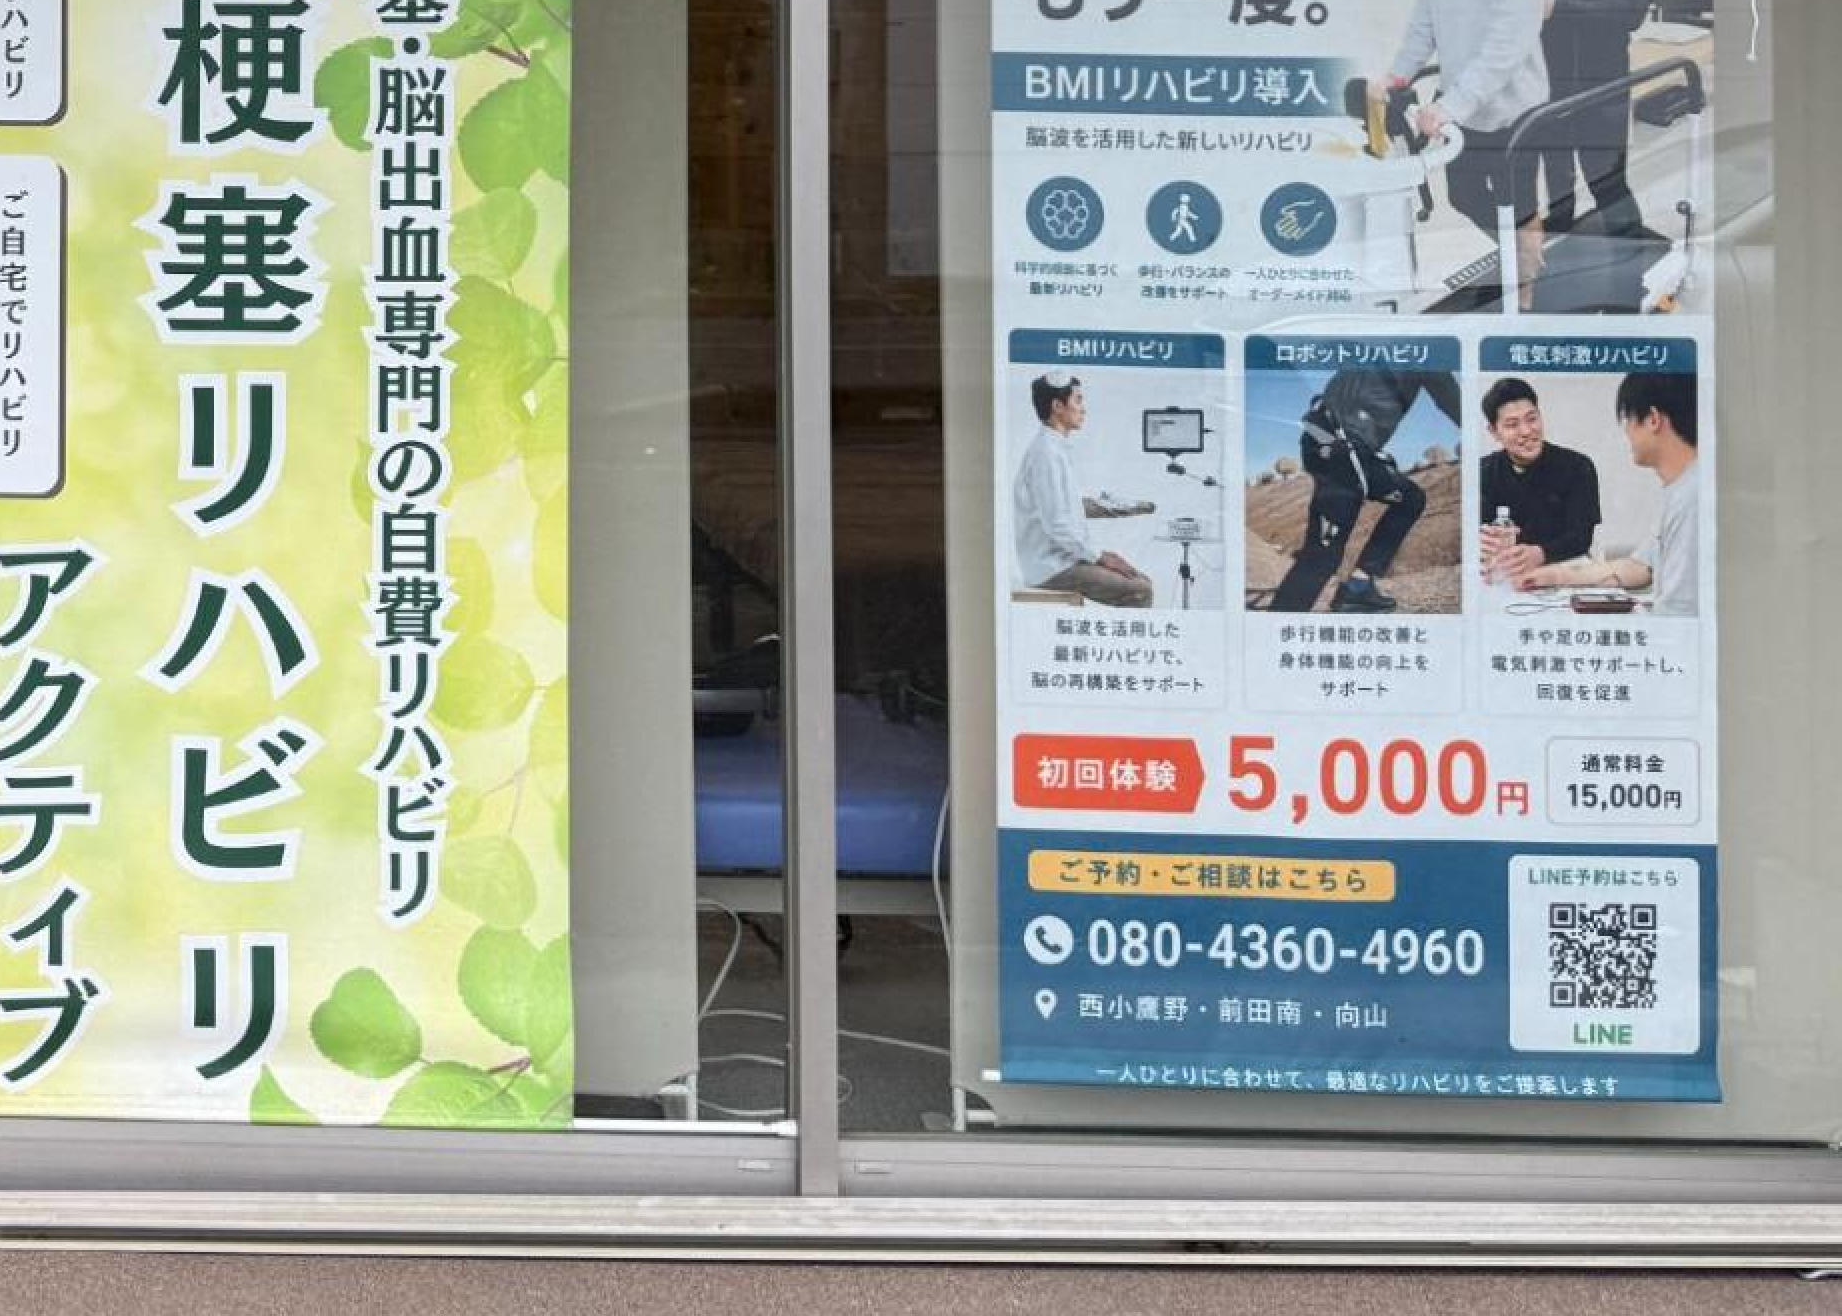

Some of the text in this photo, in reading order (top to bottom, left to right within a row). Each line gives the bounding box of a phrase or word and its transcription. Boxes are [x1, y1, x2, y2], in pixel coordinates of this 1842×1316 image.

[1025, 64, 1328, 105] BMIリハビリ導入
[1026, 127, 1313, 153] 脳波を活用した新しいリハビリ
[1057, 339, 1174, 360] BMIリハビリ
[1276, 343, 1429, 364] ロボットリハビリ
[1509, 343, 1670, 366] 電気刺激リハビリ
[1055, 619, 1180, 639] 脳波を活用した
[1280, 625, 1428, 645] 歩行機能の改善と
[1519, 628, 1648, 648] 手や足の運動を
[1279, 651, 1429, 671] 身体機能の向上を
[1491, 654, 1684, 676] 電気刺激でサポートし、
[1031, 671, 1205, 692] 脳の再構築をサポート
[1321, 679, 1388, 698] サポート
[1537, 683, 1630, 703] 回復を促進
[1037, 757, 1177, 791] 初回体験
[1581, 754, 1665, 773] 通常料金
[1228, 736, 1528, 824] 5,000円
[1567, 784, 1681, 809] 15,000円
[1528, 867, 1677, 887] LINE予約はこちら
[1088, 919, 1483, 975] 080-4360-4960
[1573, 1024, 1633, 1045] LINE
